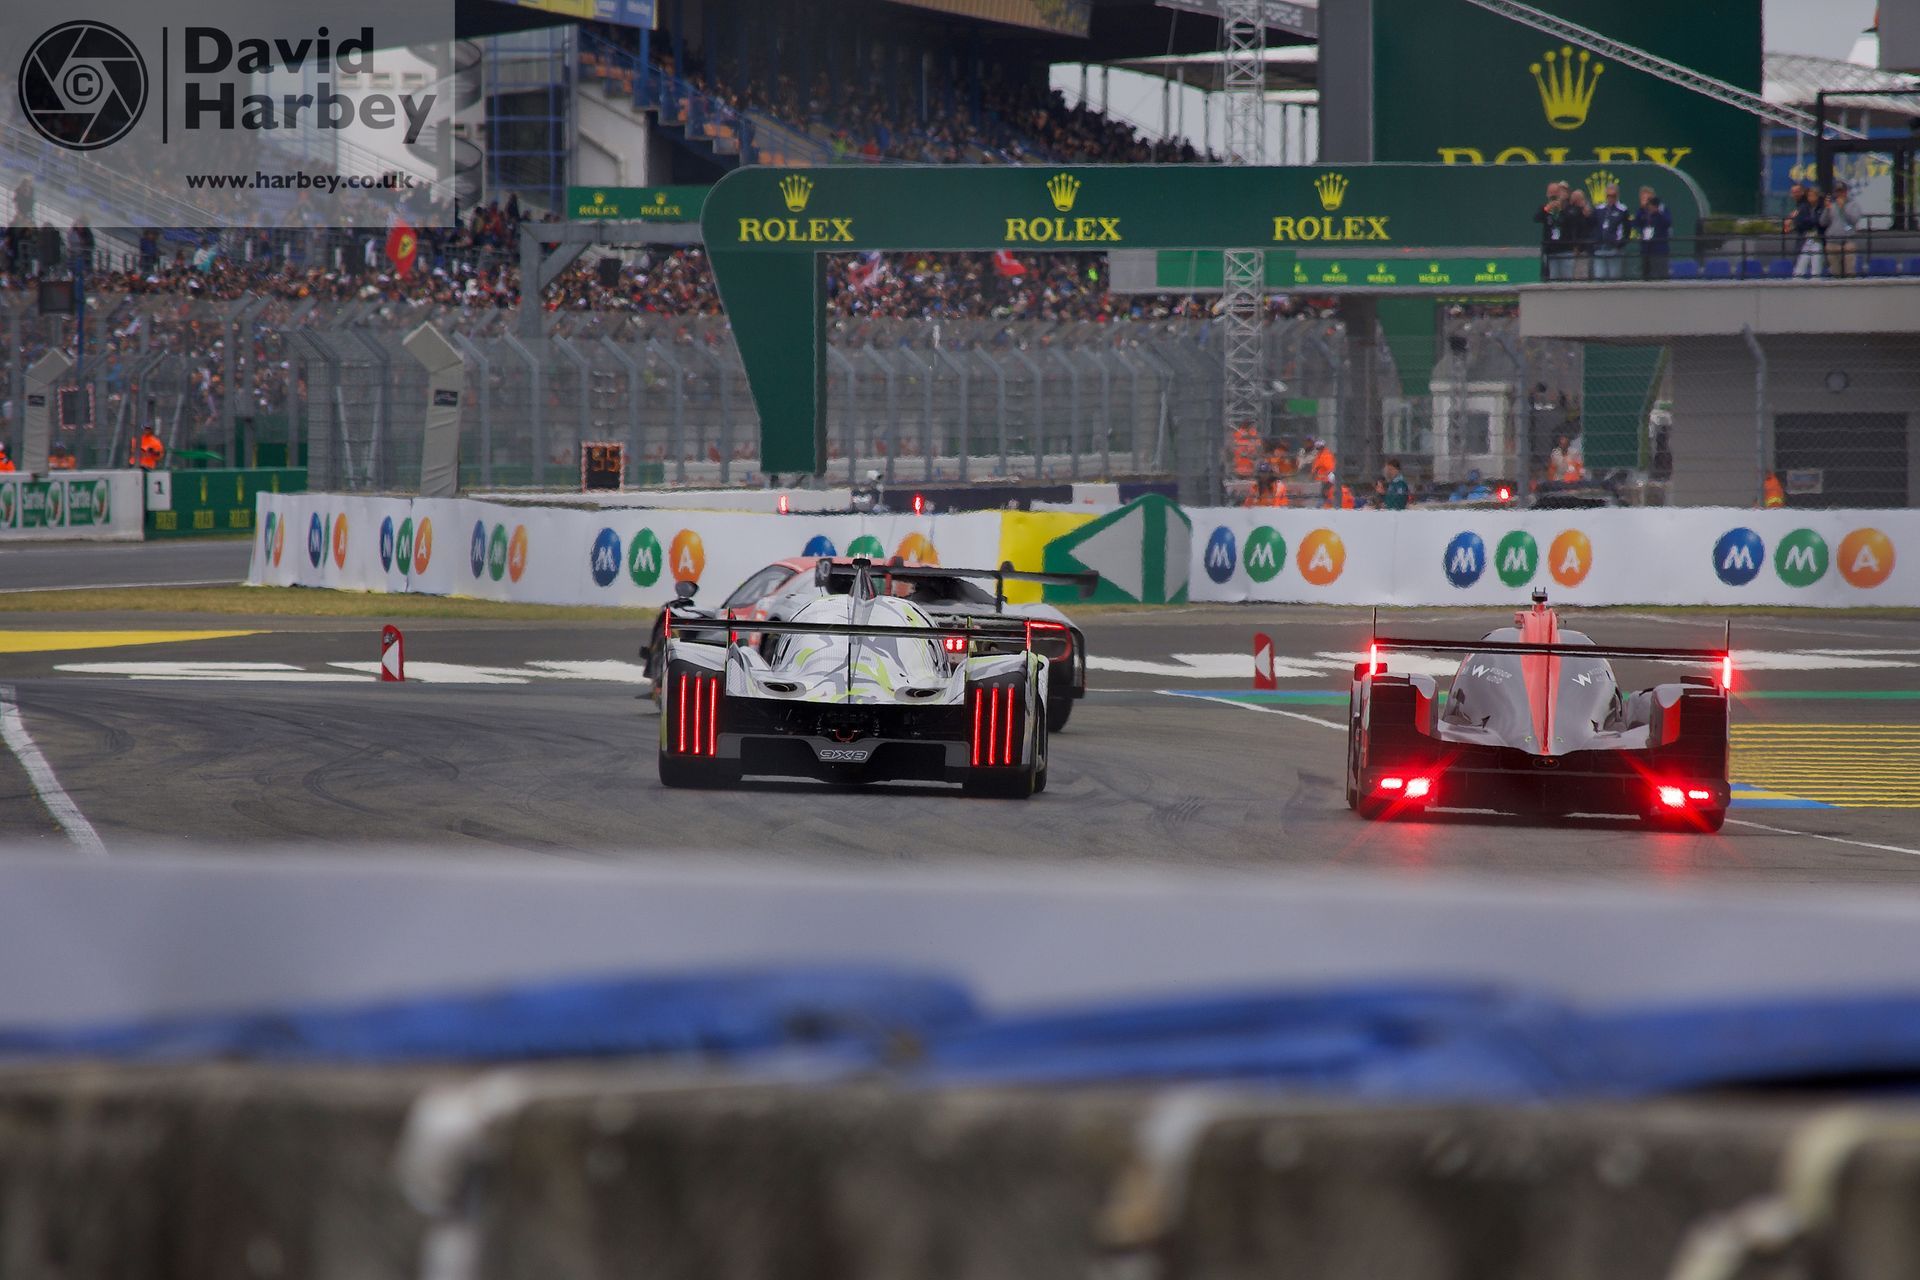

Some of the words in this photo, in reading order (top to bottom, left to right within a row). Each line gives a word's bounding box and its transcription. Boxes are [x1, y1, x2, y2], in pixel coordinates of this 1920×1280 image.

[579, 206, 618, 216] ROLEX
[640, 206, 681, 216] ROLEX
[738, 218, 854, 242] ROLEX
[1004, 217, 1122, 241] ROLEX
[1272, 216, 1392, 240] ROLEX
[153, 481, 165, 495] 1
[819, 749, 868, 761] 9X8
